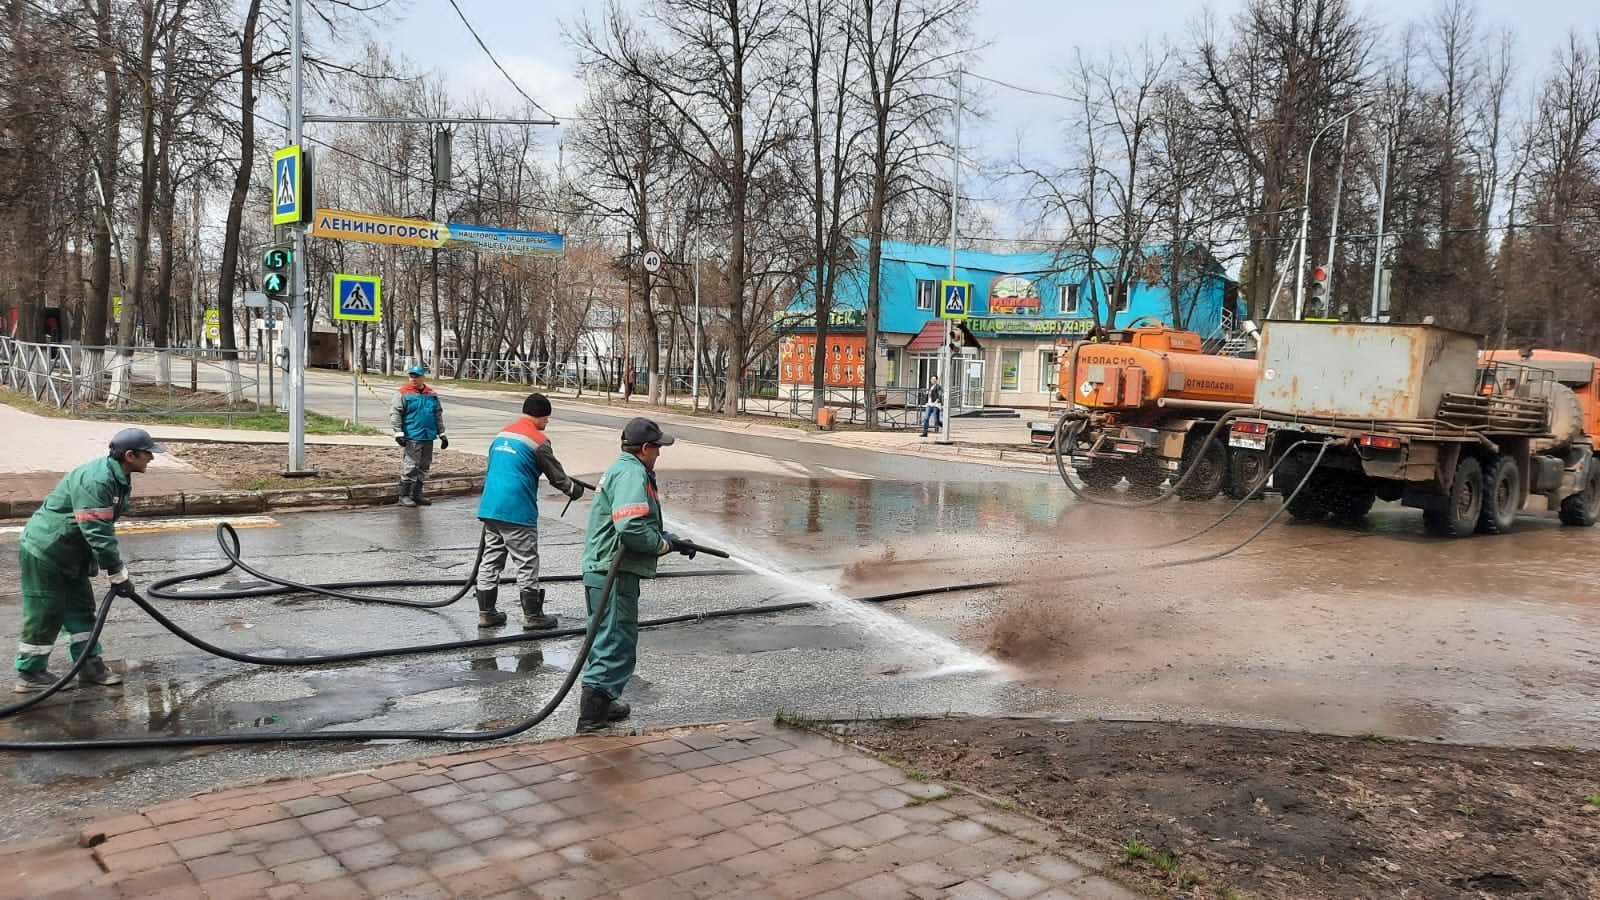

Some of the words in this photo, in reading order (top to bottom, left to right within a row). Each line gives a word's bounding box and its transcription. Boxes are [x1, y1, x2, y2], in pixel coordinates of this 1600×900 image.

[320, 217, 439, 241] ЛЕНИНОГОРСК
[266, 253, 282, 267] 15
[646, 256, 658, 266] 40
[1080, 356, 1136, 365] НЕОПАСНО
